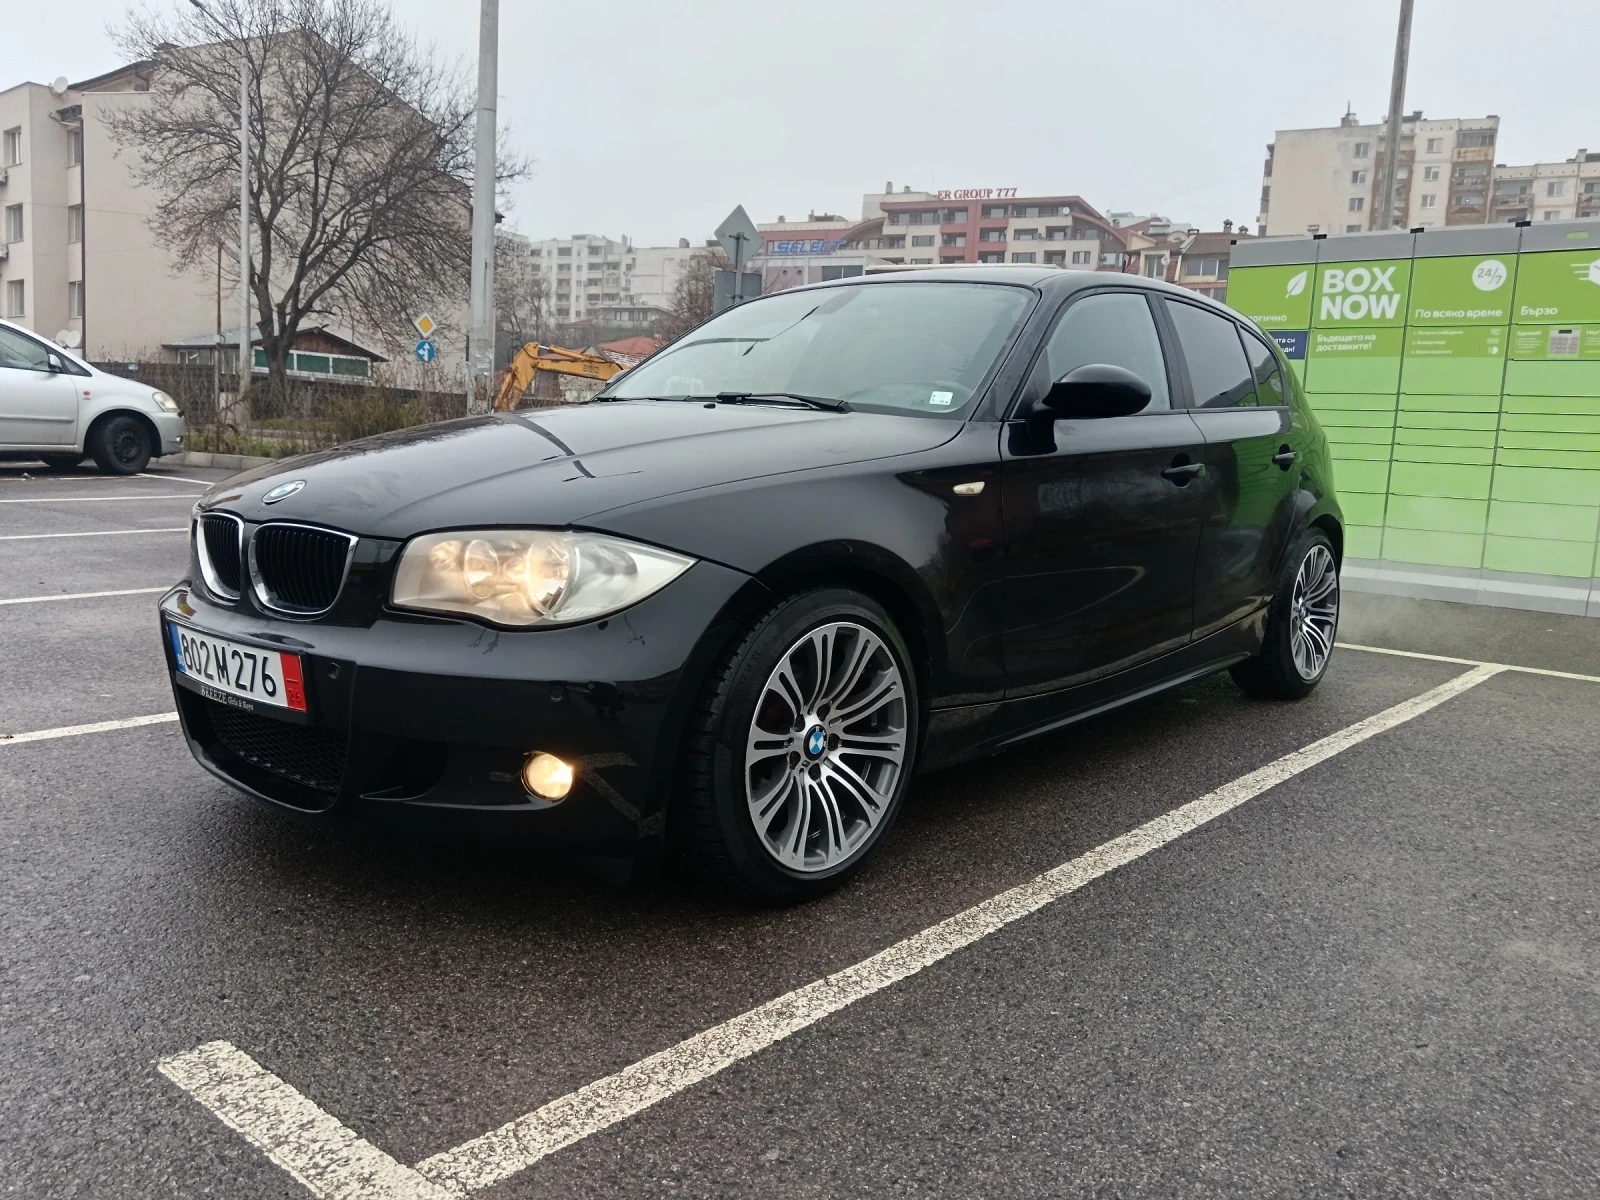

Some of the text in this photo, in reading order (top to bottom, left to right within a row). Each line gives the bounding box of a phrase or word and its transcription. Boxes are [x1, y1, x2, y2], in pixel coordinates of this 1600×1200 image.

[954, 188, 993, 199] GROUP
[996, 188, 1017, 198] 777
[777, 240, 847, 254] SELECT
[1322, 266, 1397, 294] BOX
[1476, 267, 1503, 285] 24/7
[1320, 293, 1401, 320] NOW
[1520, 306, 1558, 318] Бързо
[1415, 309, 1503, 319] По всяко време
[1317, 334, 1364, 342] Бъдещето
[1316, 342, 1372, 352] доставките!
[201, 686, 227, 704] BREEZE
